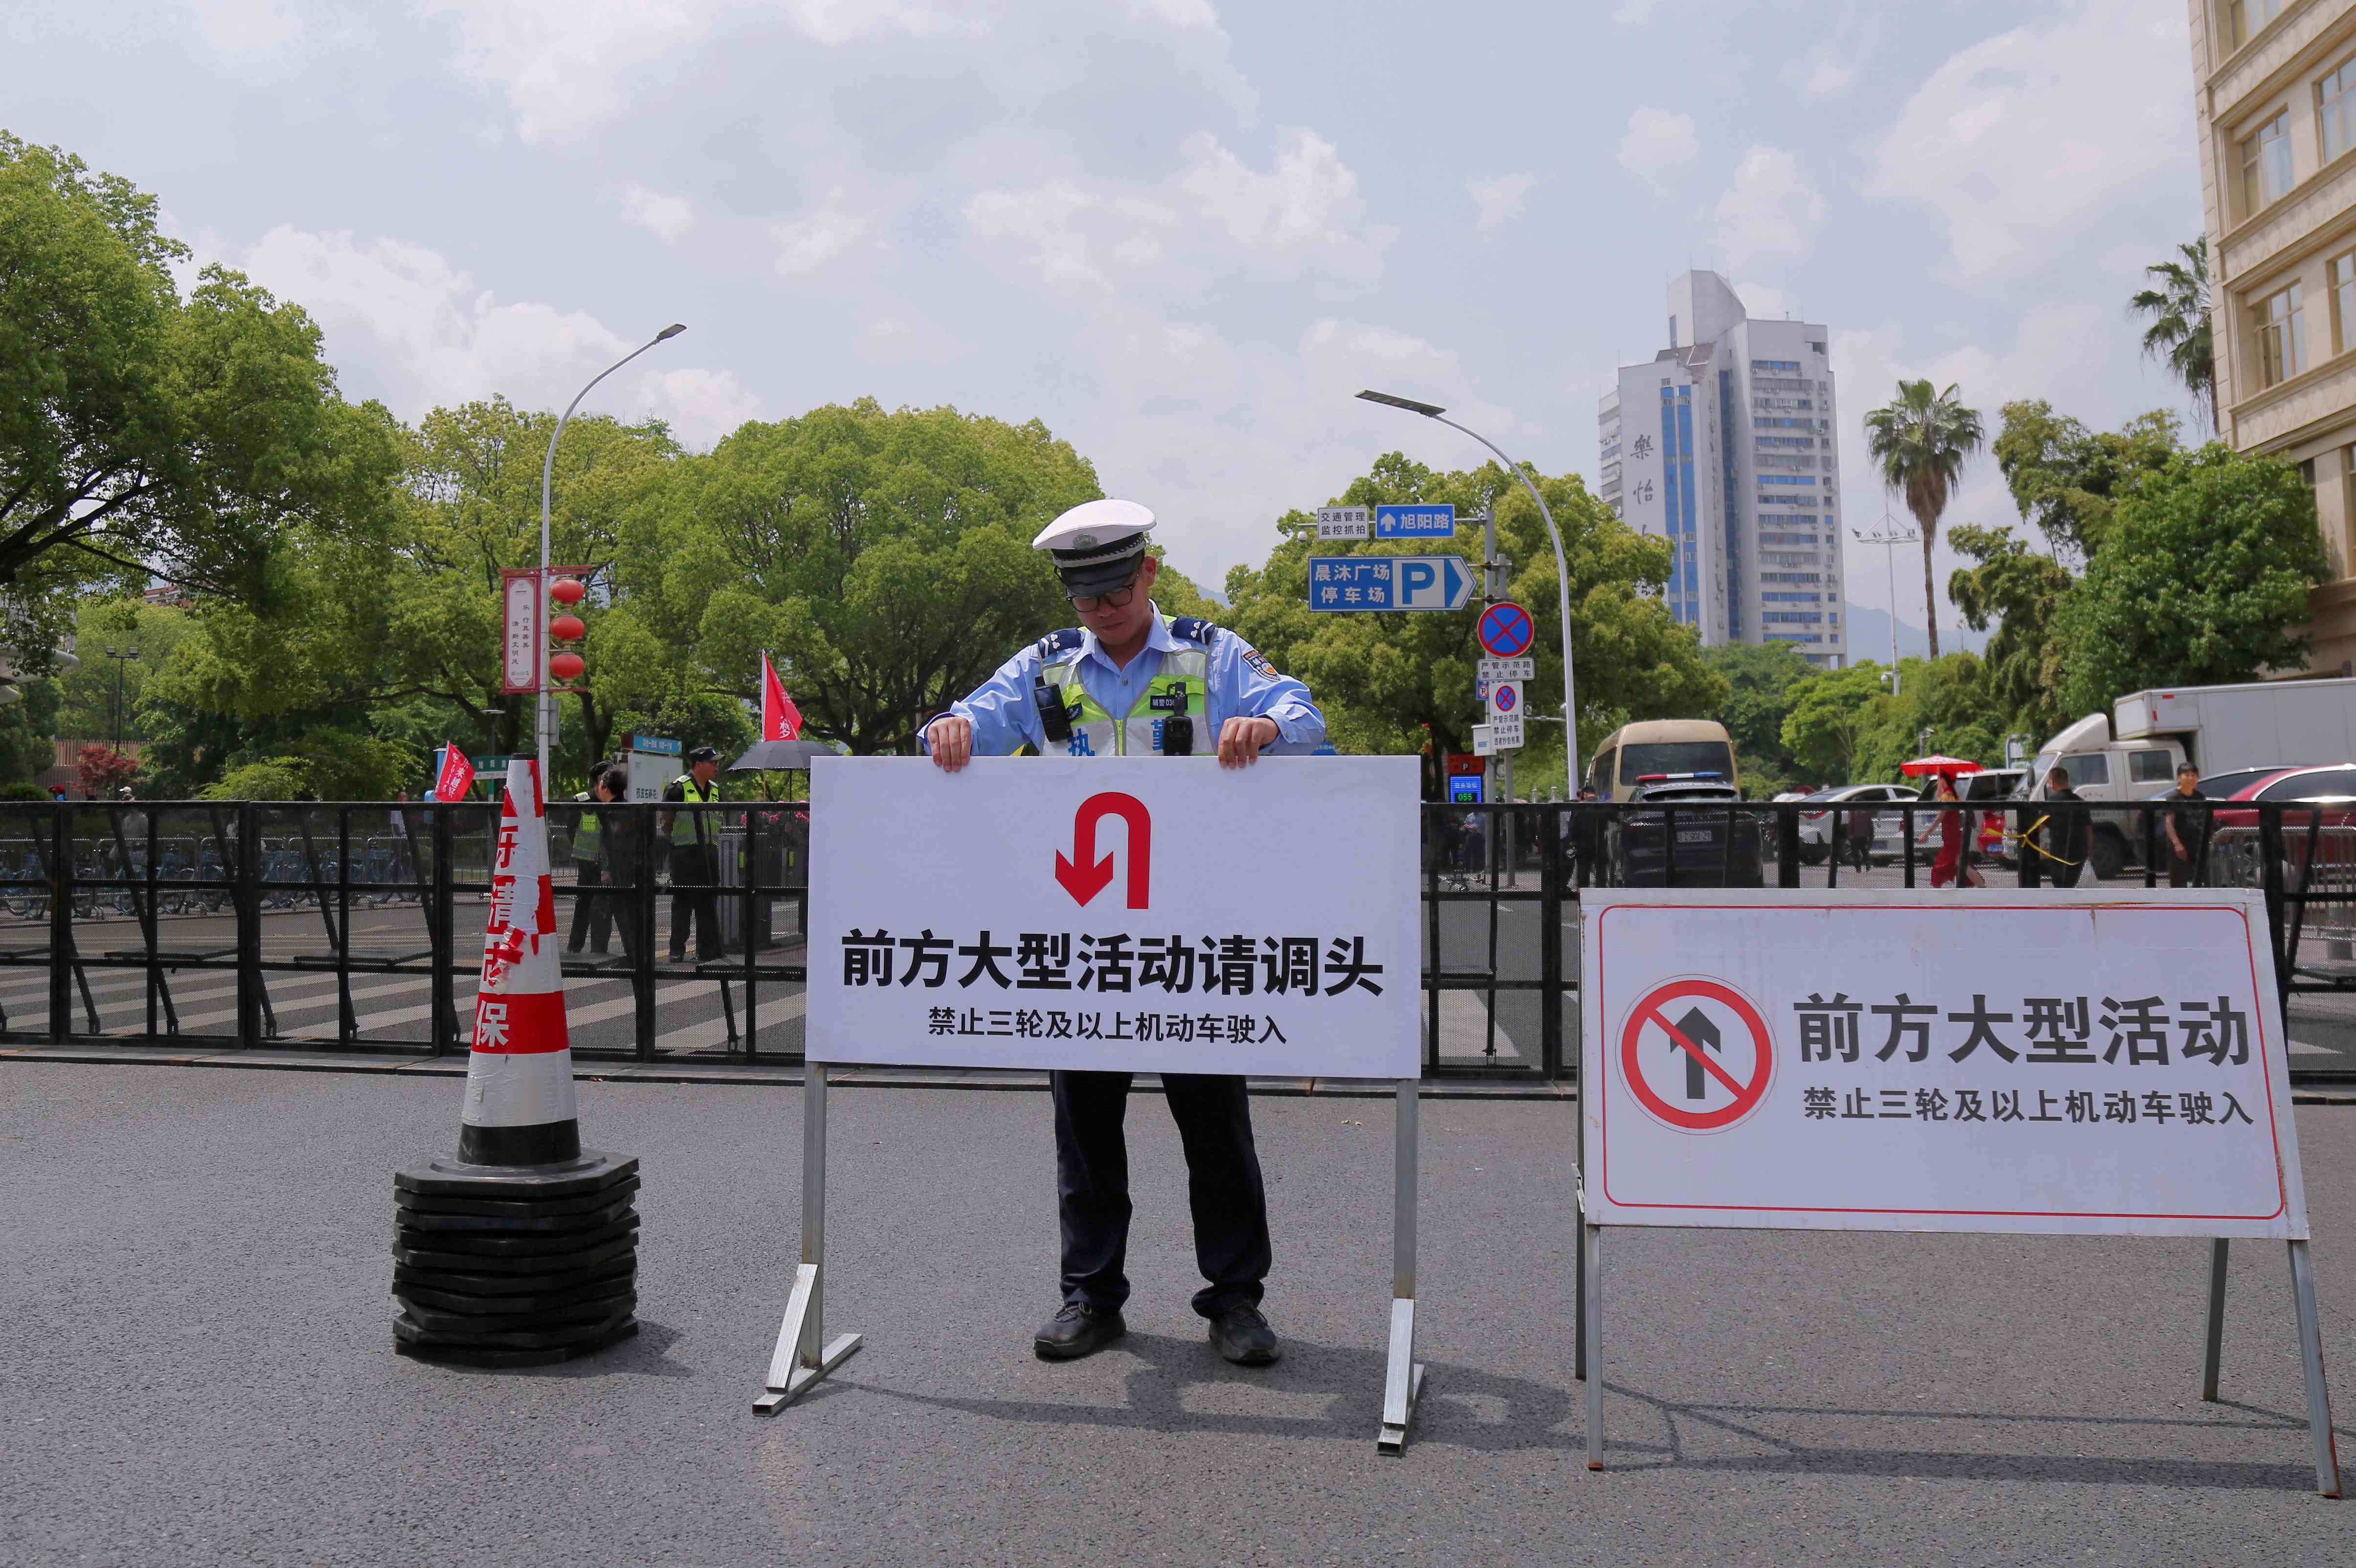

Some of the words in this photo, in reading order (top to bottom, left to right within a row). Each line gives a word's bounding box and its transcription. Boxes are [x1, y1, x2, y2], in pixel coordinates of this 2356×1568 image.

[1630, 434, 1654, 536] 樂怡
[1321, 512, 1365, 522] 交通管理
[1400, 513, 1449, 529] 旭阳路
[1321, 524, 1366, 535] 监控抓拍
[1315, 564, 1390, 582] 晨沐广场
[1401, 562, 1436, 605] P
[1321, 586, 1385, 604] 停车场
[1482, 661, 1531, 670] 严管示范路
[1482, 670, 1532, 679] 禁止停车
[1493, 714, 1519, 724] 严管示范路
[1494, 725, 1519, 735] 禁止停车
[841, 928, 1384, 997] 前方大型活动请调头
[928, 1006, 1287, 1045] 禁止三轮及以上机动车驶入
[1793, 993, 2250, 1066] 前方大型活动
[1803, 1087, 2254, 1125] 禁止三轮及以上机动车驶入
